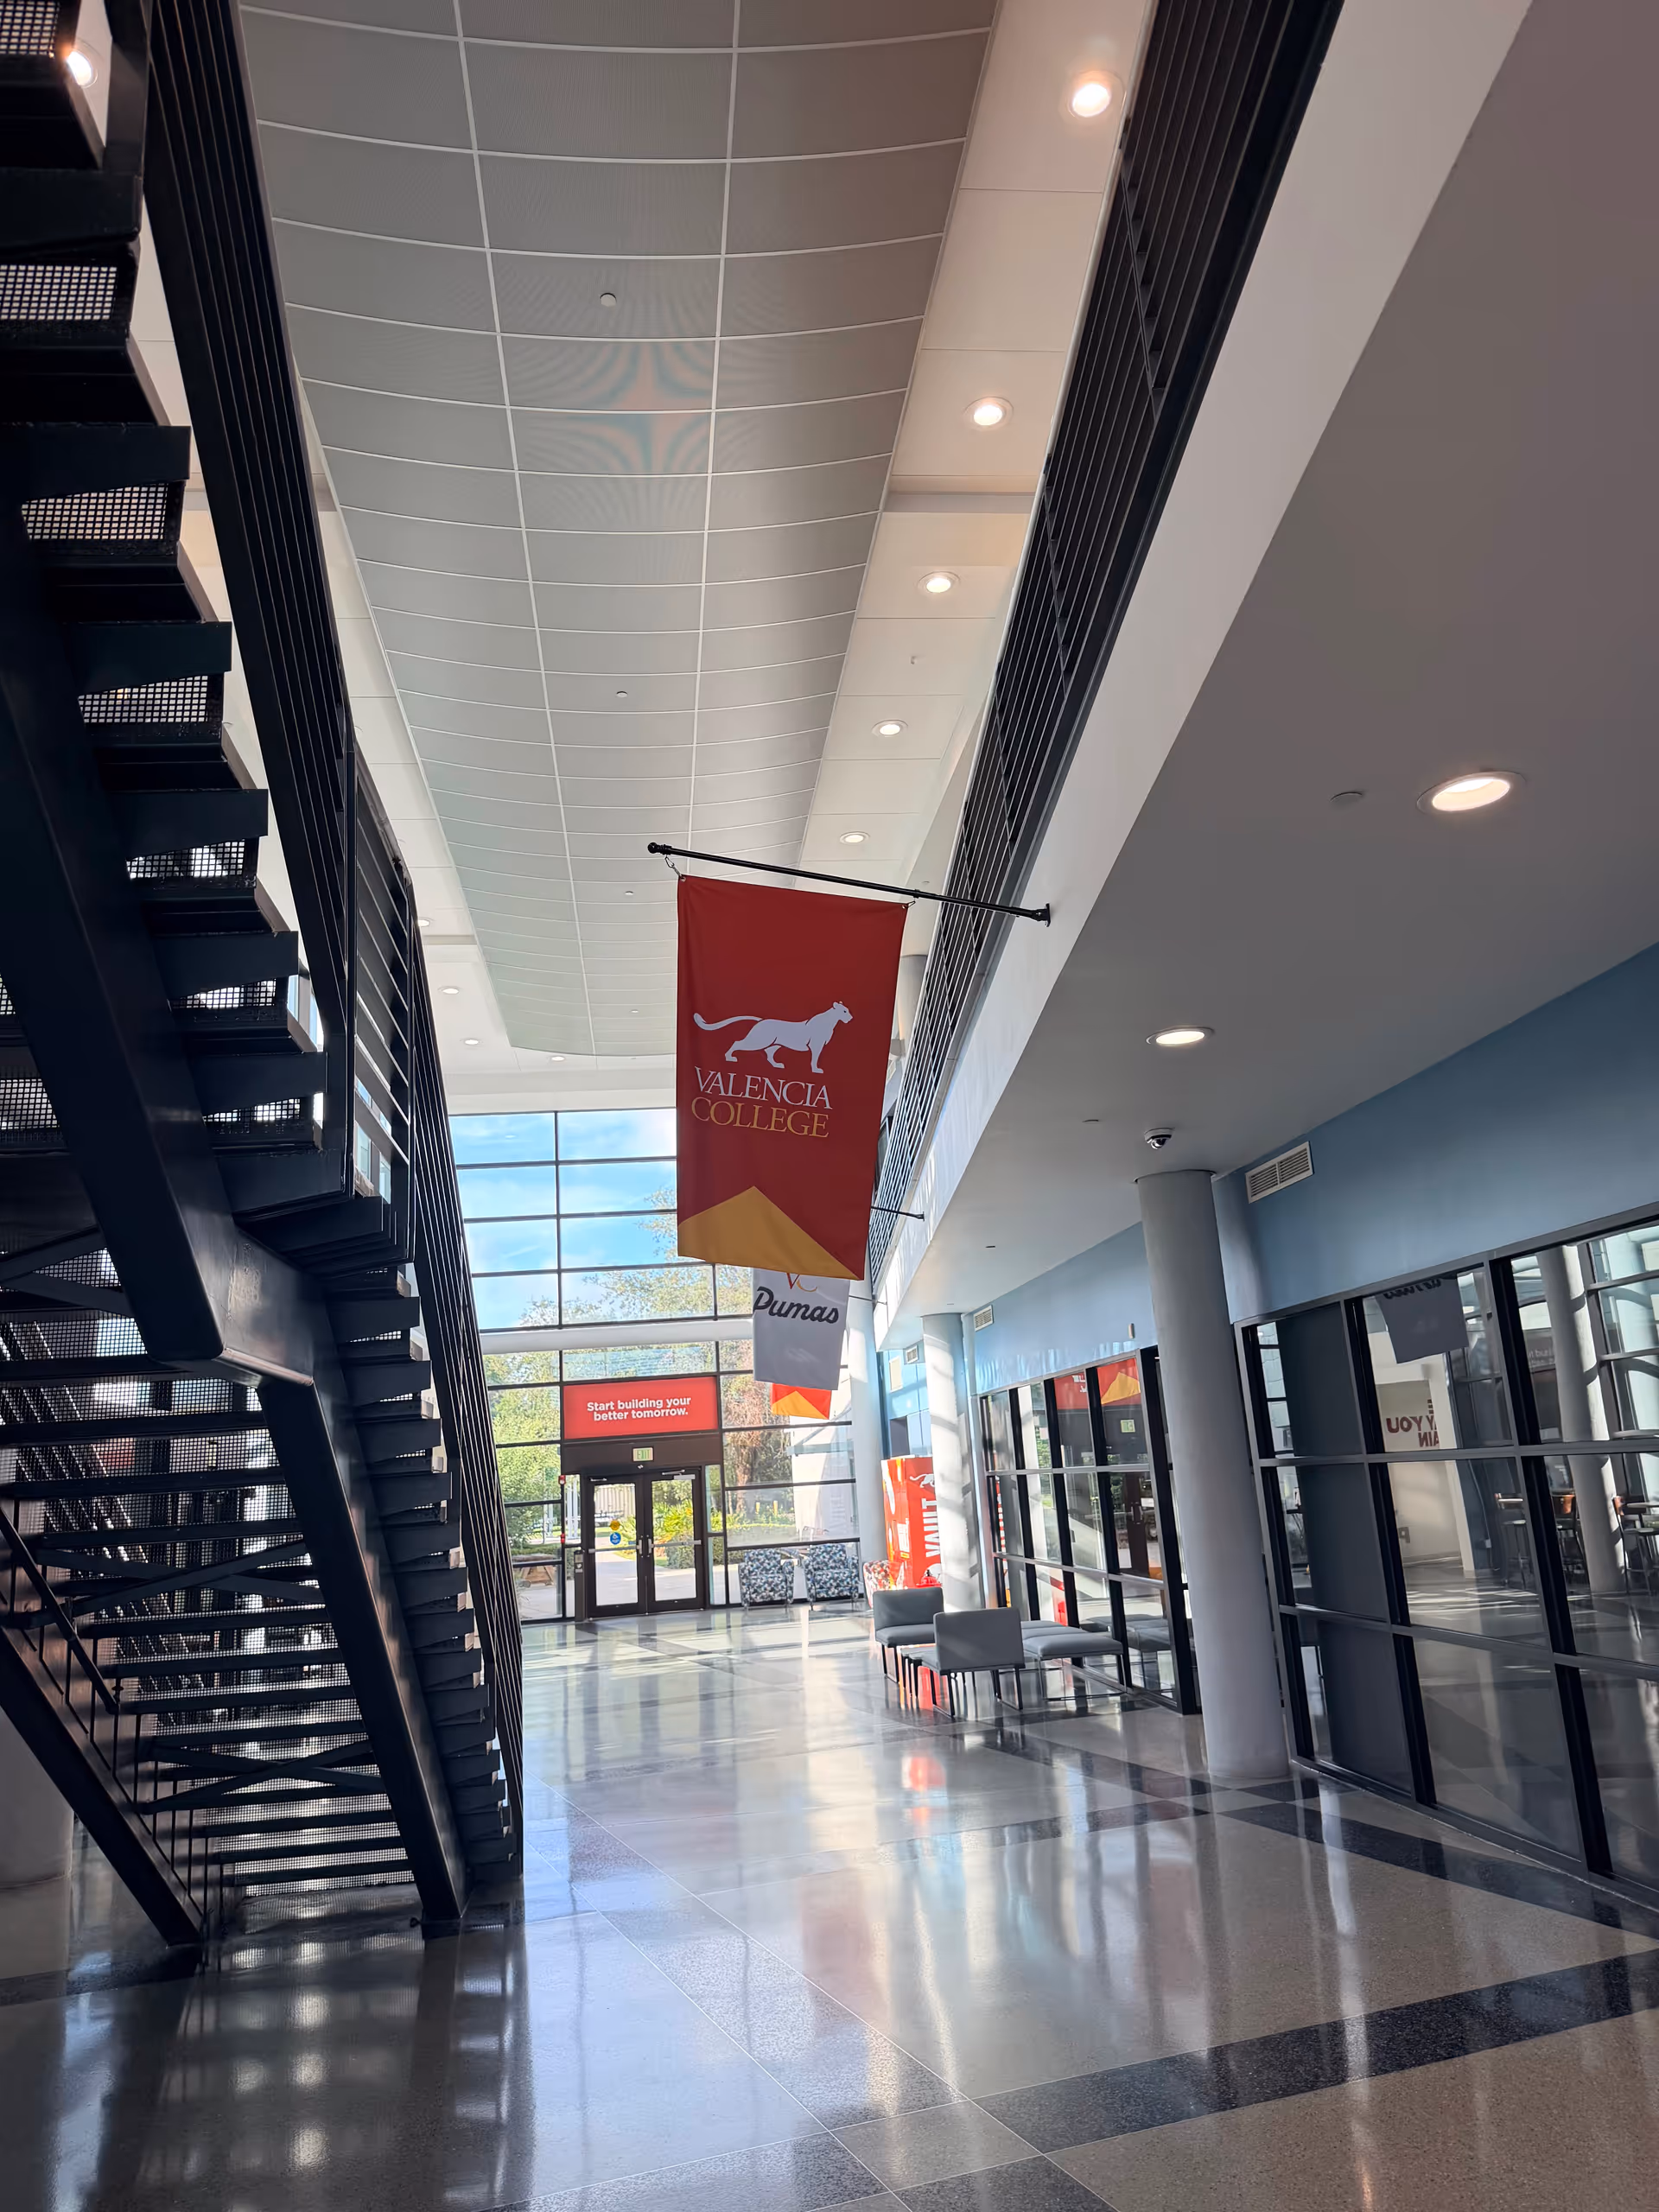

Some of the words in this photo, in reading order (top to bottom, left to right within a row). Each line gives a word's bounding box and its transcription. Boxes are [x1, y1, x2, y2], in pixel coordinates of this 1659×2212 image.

[694, 1065, 833, 1109] VALENCIA
[691, 1096, 830, 1138] COLLEGE
[753, 1286, 839, 1324] Pumas
[587, 1401, 615, 1412] Start
[617, 1398, 664, 1410] building
[666, 1397, 692, 1408] your
[594, 1410, 629, 1421] better
[631, 1407, 689, 1419] tomorrow.
